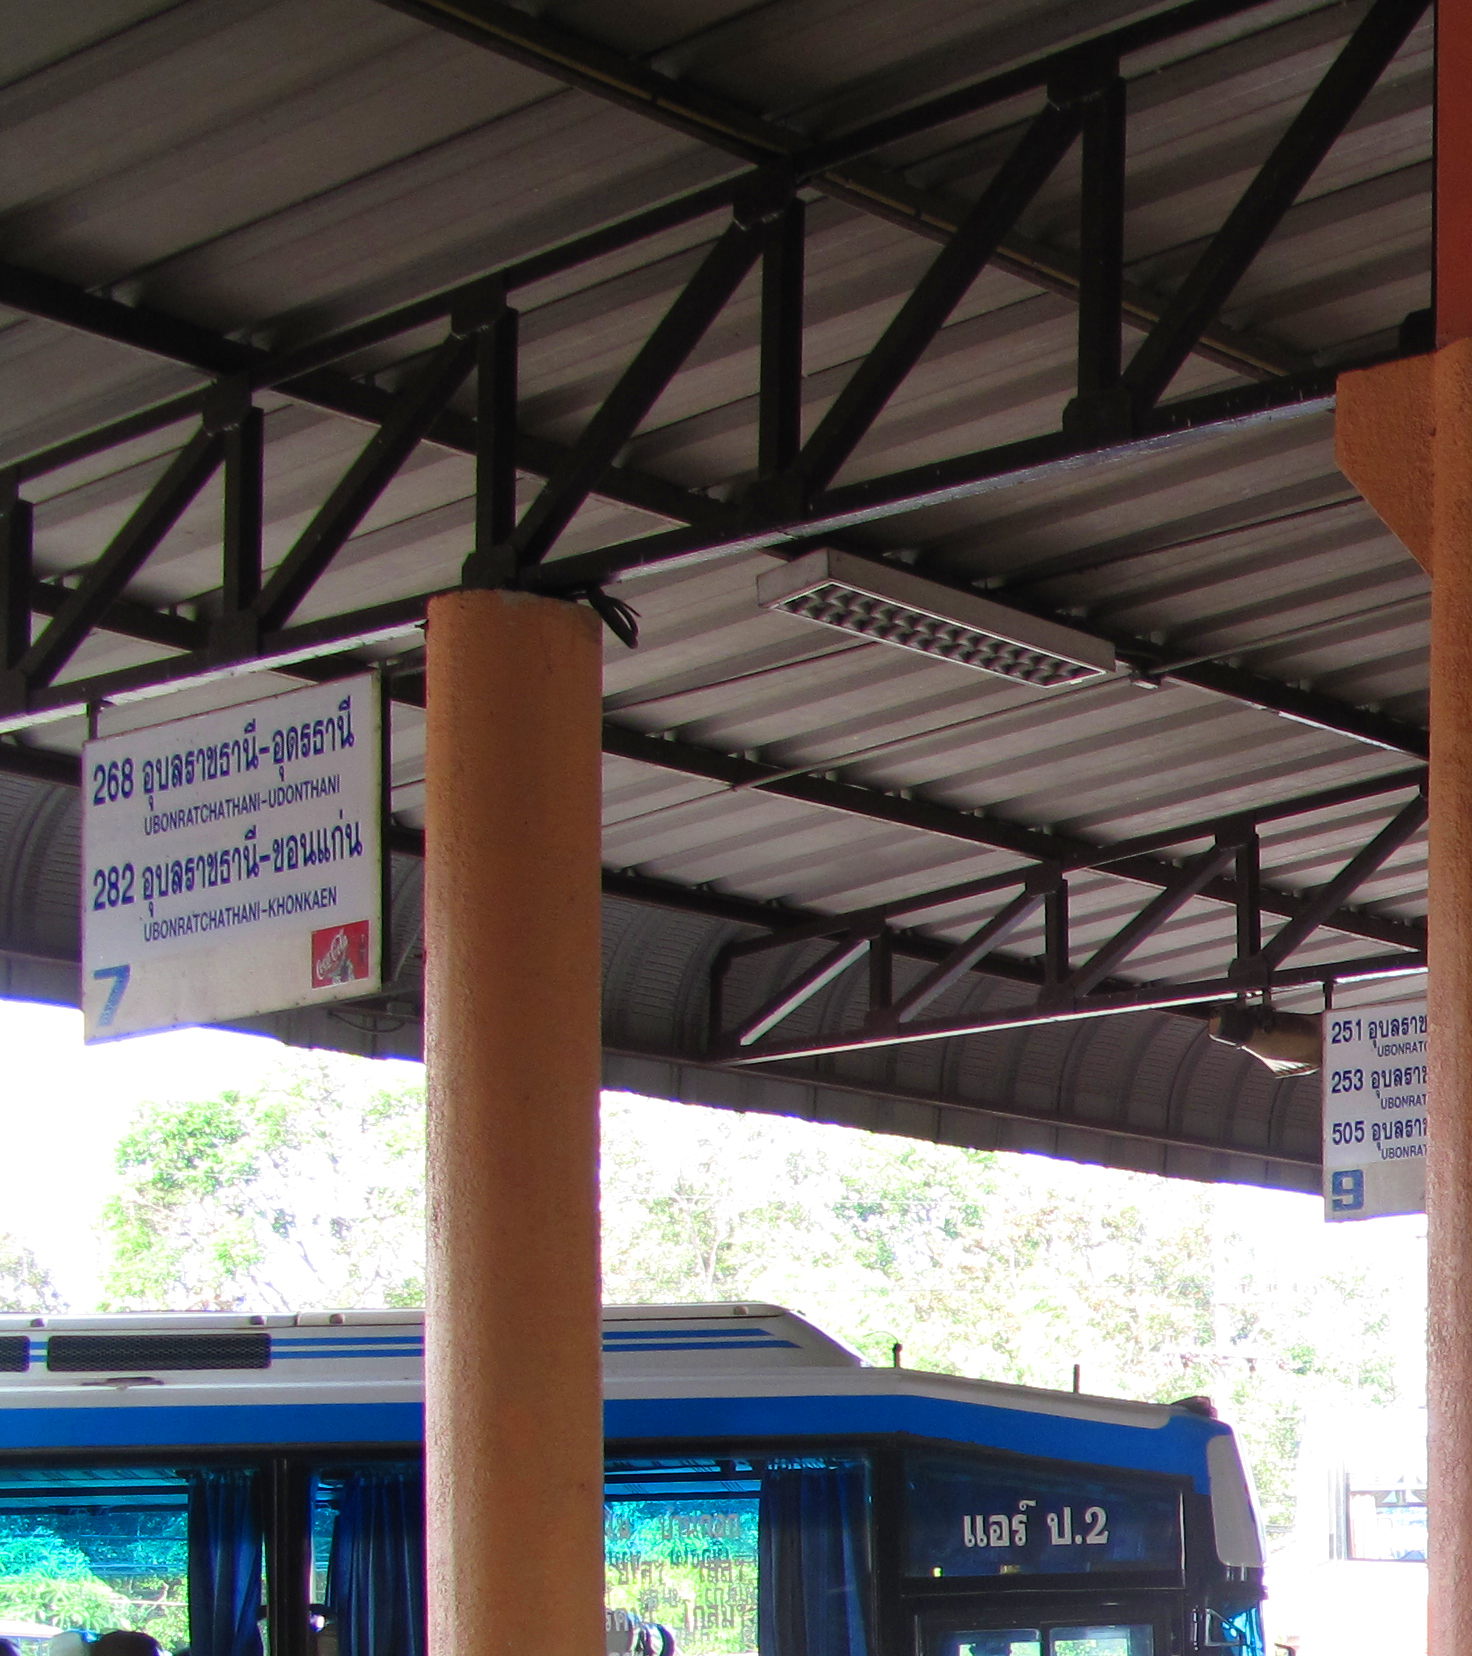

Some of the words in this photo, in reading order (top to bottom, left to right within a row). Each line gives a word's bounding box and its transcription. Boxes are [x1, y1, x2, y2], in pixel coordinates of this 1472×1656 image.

[93, 757, 134, 806] 268
[144, 774, 340, 835] UBONRATCHATHANI-UDONTHANI
[93, 863, 135, 911] 282
[144, 886, 337, 942] UBONRATCHATHANI-KHONKAEN
[93, 964, 130, 1027] 7
[1331, 1019, 1363, 1044] 251
[1331, 1069, 1363, 1094] 253
[1332, 1121, 1364, 1145] 505
[1332, 1169, 1364, 1212] 9
[963, 1500, 1036, 1547] แอร์
[1047, 1506, 1109, 1545] ป.2
